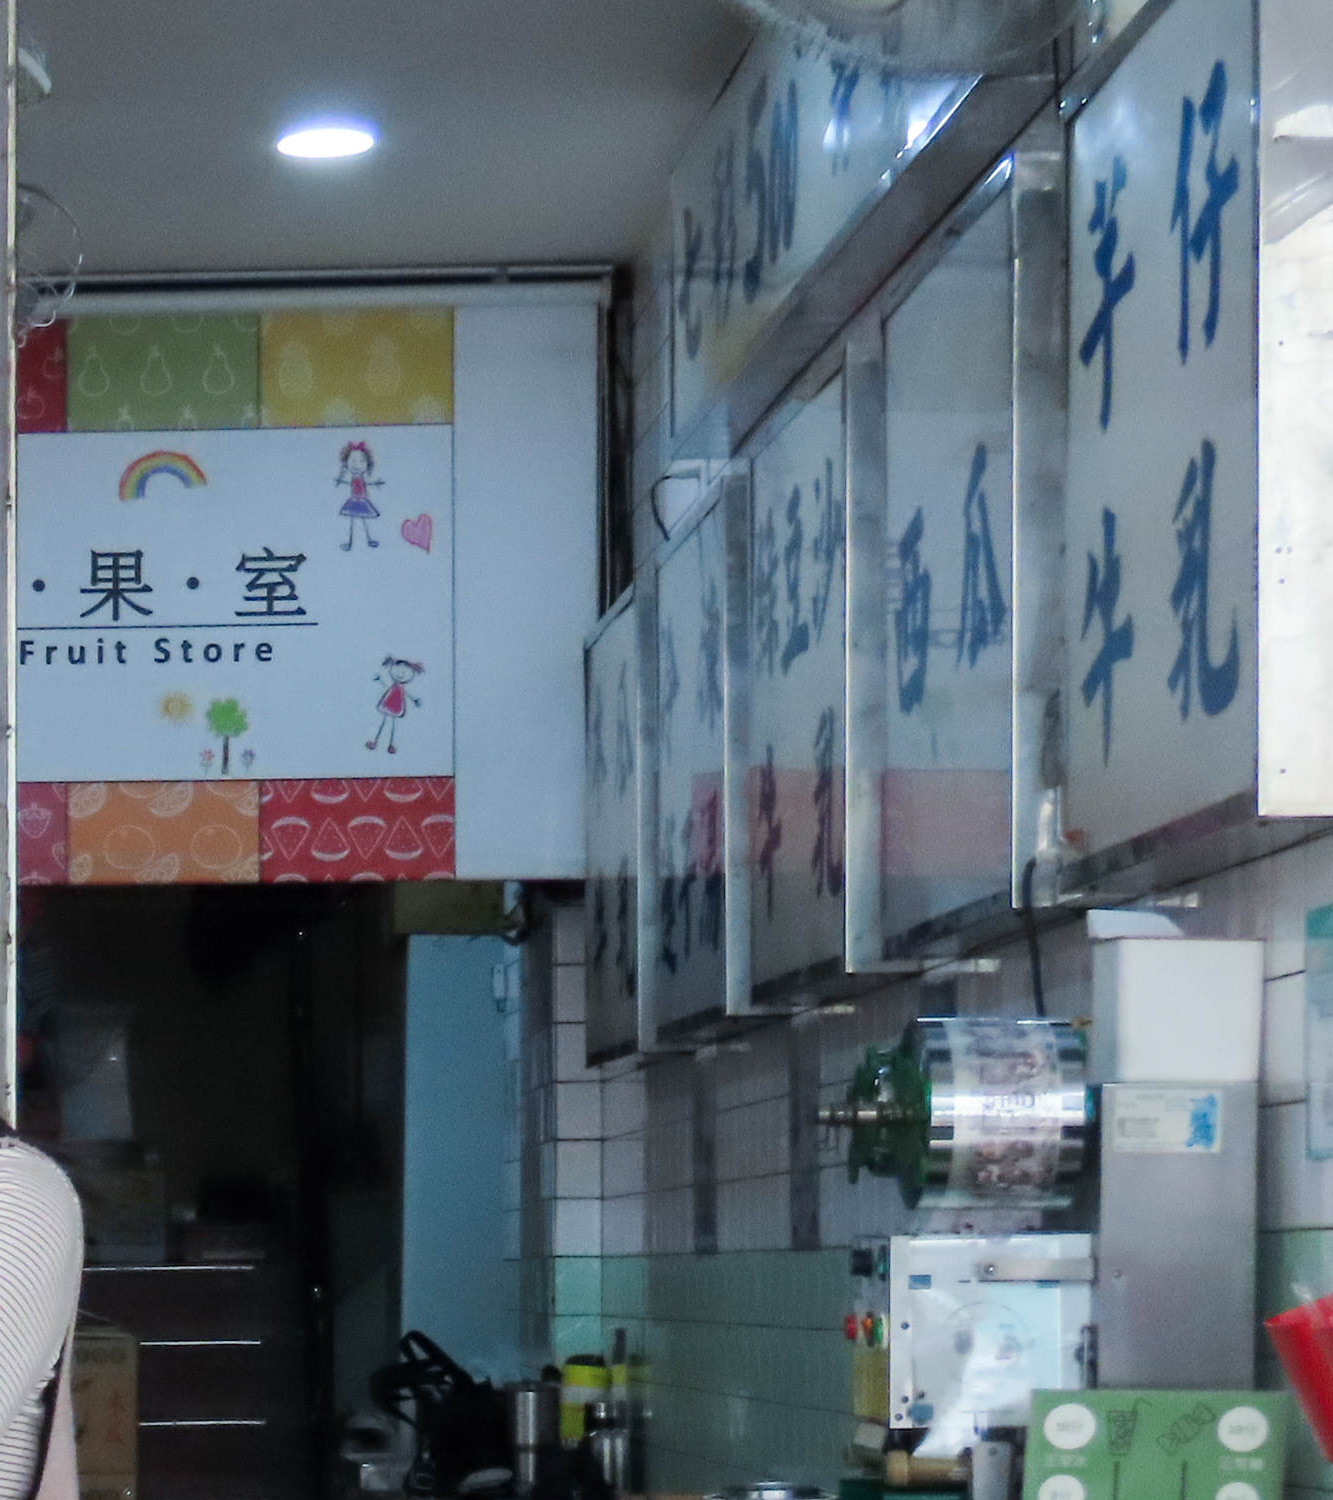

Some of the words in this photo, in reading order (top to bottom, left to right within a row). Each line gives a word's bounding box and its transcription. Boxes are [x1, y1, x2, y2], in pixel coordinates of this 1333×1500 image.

[20, 639, 128, 666] Fruit
[153, 637, 275, 665] Store
[1079, 438, 1241, 767] 牛乳
